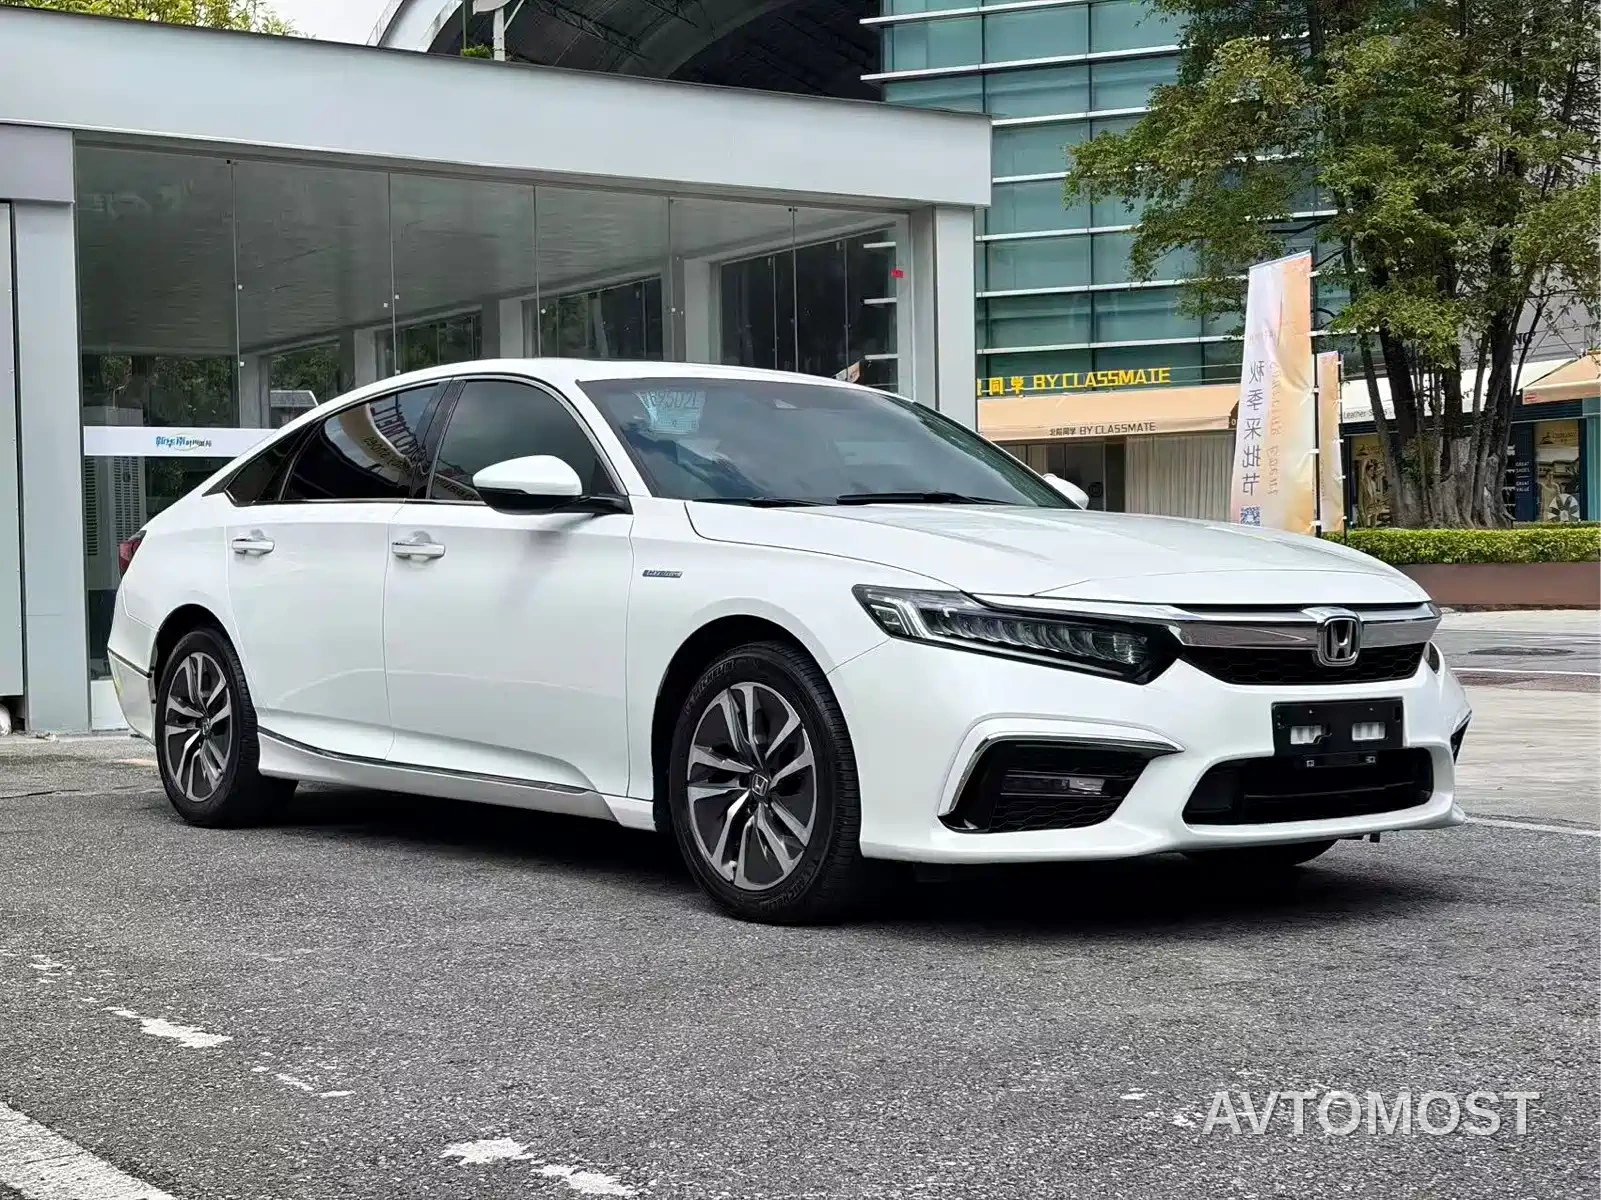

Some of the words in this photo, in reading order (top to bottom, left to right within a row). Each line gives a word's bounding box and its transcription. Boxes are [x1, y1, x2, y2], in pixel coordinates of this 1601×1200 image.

[1033, 374, 1060, 390] BY
[1062, 367, 1171, 389] CLASSMATE
[1079, 425, 1094, 436] BY
[1095, 422, 1156, 435] CLASSMATE
